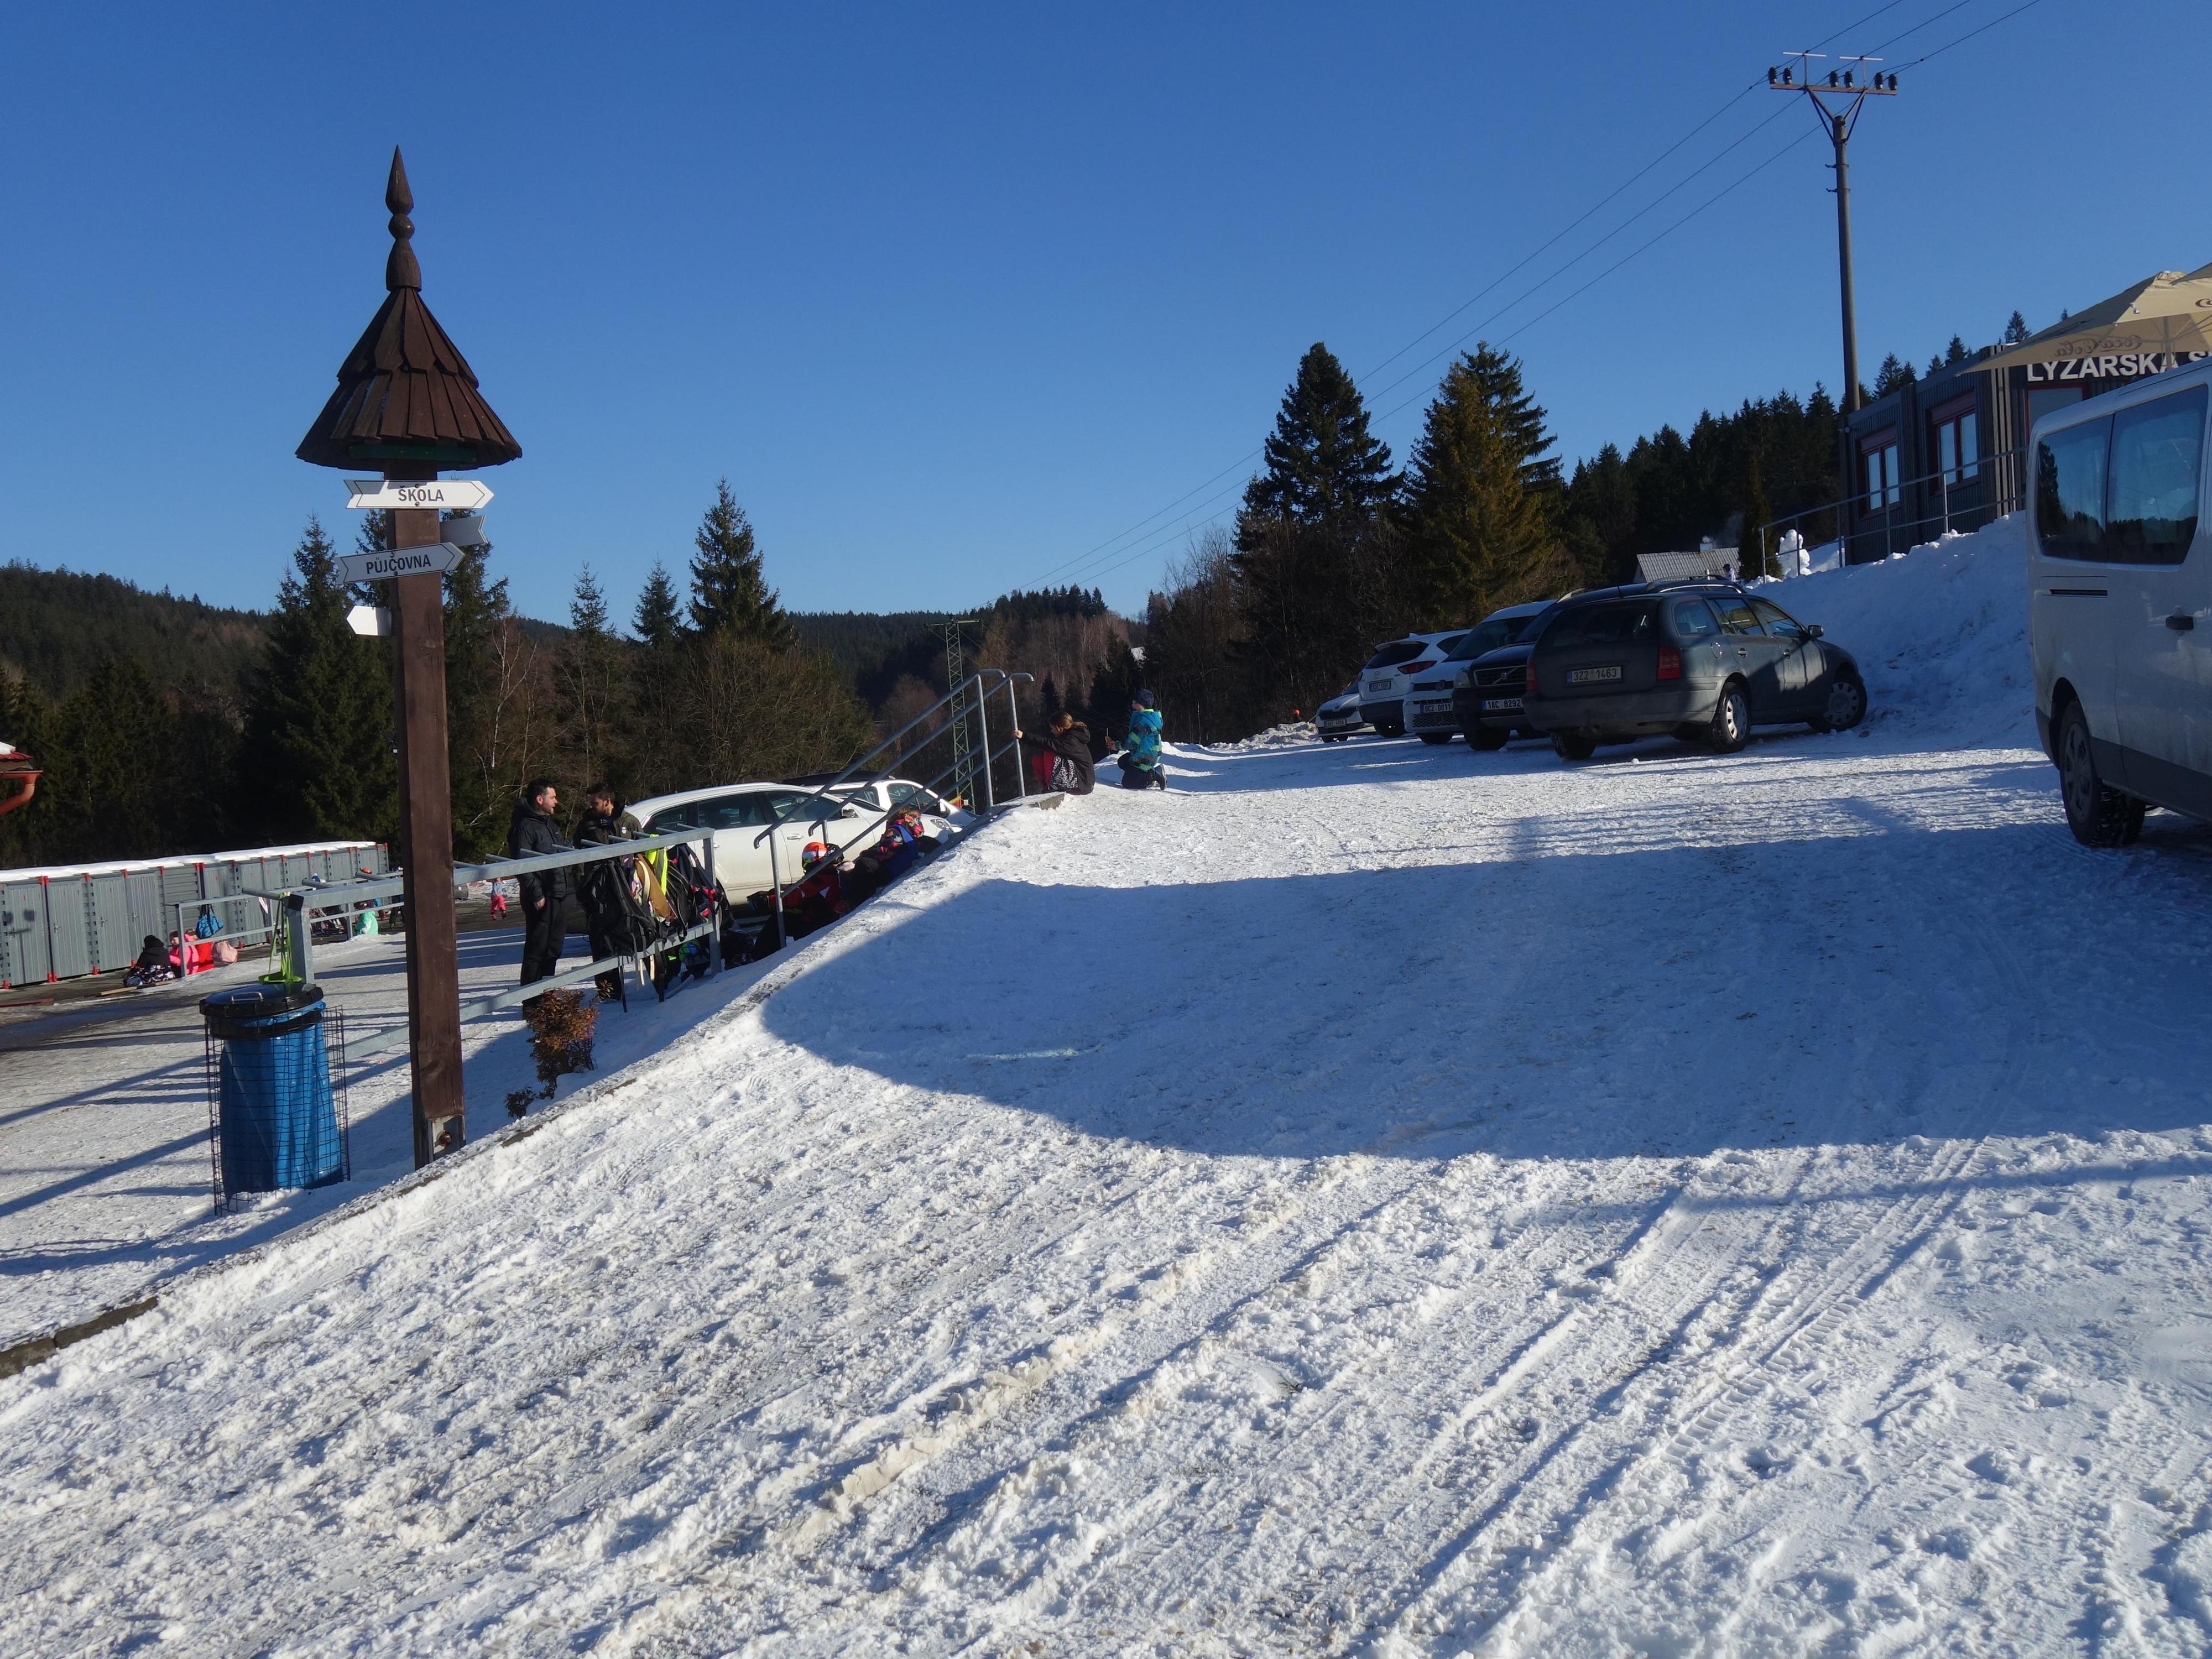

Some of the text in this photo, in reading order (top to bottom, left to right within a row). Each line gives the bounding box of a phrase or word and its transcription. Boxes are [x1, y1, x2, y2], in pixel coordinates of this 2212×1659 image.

[398, 485, 444, 502] ŠKOLA
[366, 554, 431, 574] PŮJČOVNA
[1596, 667, 1617, 679] 1463
[1488, 699, 1521, 709] 1AC 8292
